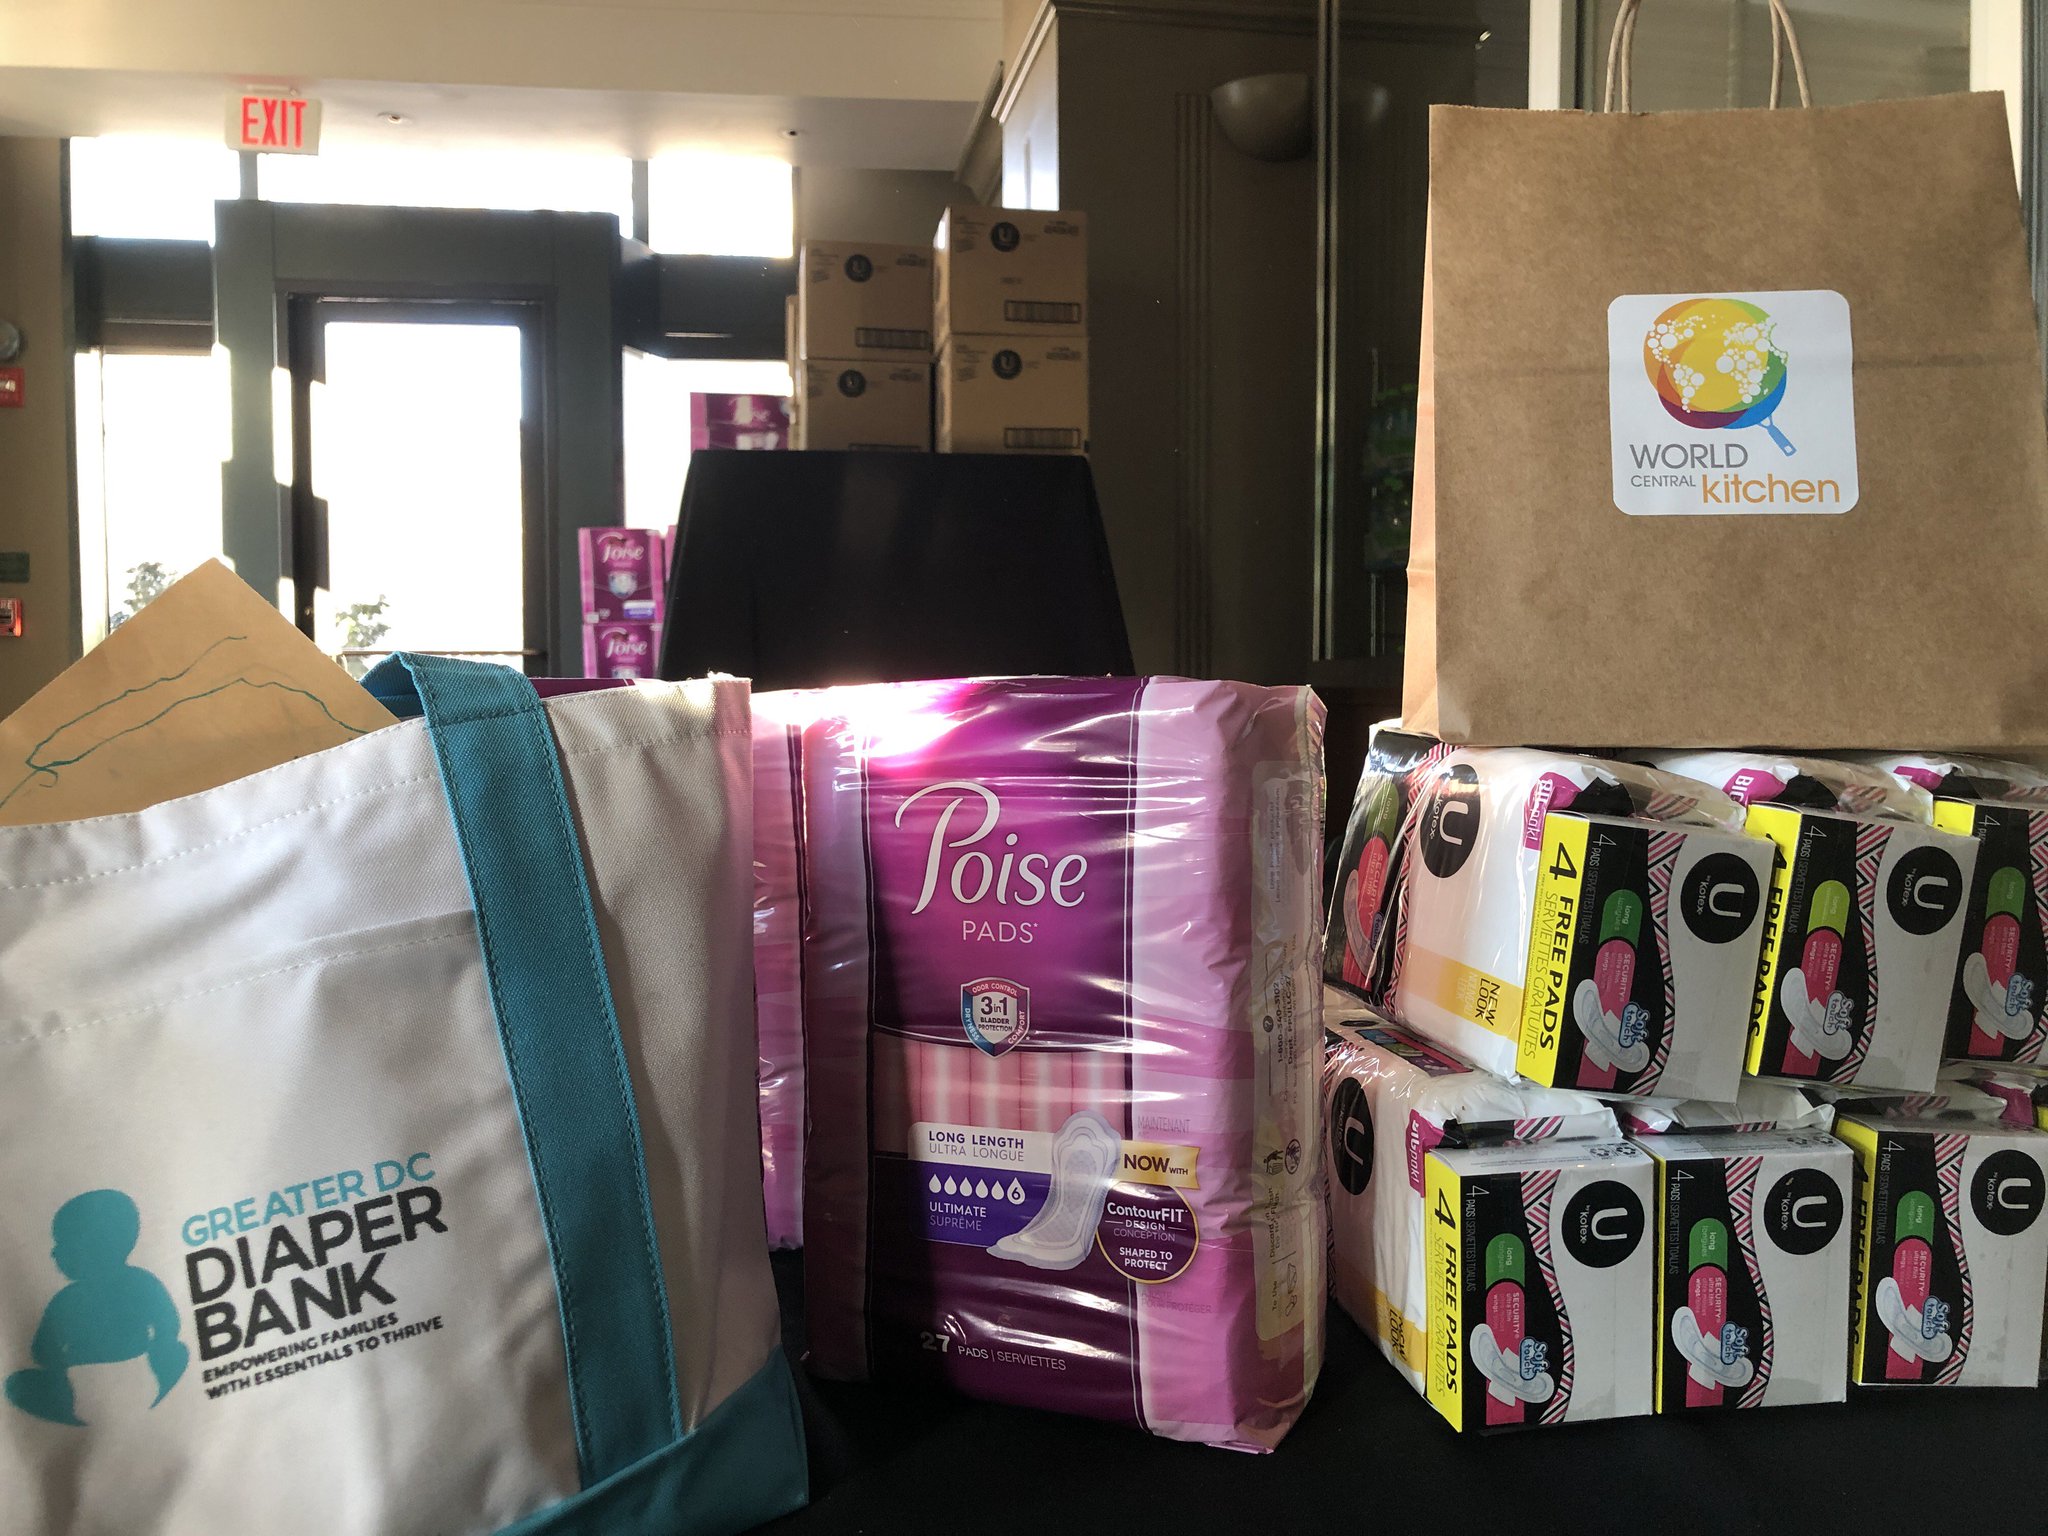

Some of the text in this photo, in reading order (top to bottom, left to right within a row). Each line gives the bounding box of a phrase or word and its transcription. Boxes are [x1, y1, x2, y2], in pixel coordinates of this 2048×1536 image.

[242, 97, 308, 149] EXIT
[1629, 443, 1749, 469] WORLD
[1630, 473, 1840, 503] CENTRAL kitchen
[1440, 801, 1469, 845] U
[1803, 825, 1828, 838] 4
[1977, 814, 2001, 827] 4
[895, 781, 1088, 915] Poise
[1592, 833, 1617, 847] 4
[1709, 883, 1745, 918] U
[1913, 875, 1949, 910] U
[1621, 905, 1633, 925] long
[962, 920, 1035, 944] PADS
[1535, 890, 1558, 976] SERVIETTES
[1539, 842, 1578, 1050] 4 FREE PADS
[972, 983, 1018, 997] ODOR CONTROL
[1474, 978, 1491, 1018] LOOK
[1485, 982, 1501, 1026] NEW
[964, 1007, 980, 1041] DRYNESS
[978, 1024, 1013, 1032] PROTECTION
[980, 1016, 1010, 1025] BLADDER
[1523, 976, 1547, 1059] GRATUITES
[1622, 1009, 1635, 1043] touch
[1630, 1009, 1649, 1043] Soft
[1827, 998, 1841, 1031] touch
[1834, 999, 1853, 1031] Soft
[929, 1130, 1024, 1149] LONG LENGTH
[1138, 1115, 1191, 1133] MAINTENANT
[929, 1143, 1025, 1162] ULTRA LONGUE
[1344, 1116, 1365, 1166] U
[1882, 1138, 1906, 1152] 4
[1124, 1153, 1189, 1176] NOW WITH
[1671, 1169, 1695, 1181] 4
[1880, 1152, 1891, 1170] PADS
[181, 1152, 435, 1247] GREATER DC
[1011, 1187, 1021, 1200] 6
[1466, 1184, 1490, 1198] 4
[1671, 1182, 1681, 1201] PADS
[1997, 1177, 2032, 1210] U
[929, 1201, 987, 1218] ULTIMATE
[929, 1214, 982, 1231] SUPRÊME
[1107, 1202, 1185, 1223] ContourFIT
[1465, 1198, 1476, 1218] PADS
[1791, 1195, 1828, 1229] U
[1915, 1204, 1925, 1223] long
[1113, 1228, 1176, 1242] CONCEPTION
[1125, 1219, 1166, 1231] DESIGN
[1591, 1207, 1628, 1241] U
[185, 1186, 448, 1306] DIAPER
[1119, 1246, 1173, 1261] SHAPED TO
[1708, 1230, 1717, 1250] long
[1124, 1258, 1168, 1271] PROTECT
[1505, 1247, 1514, 1266] long
[1434, 1187, 1457, 1394] 4 FREE PADS
[195, 1252, 397, 1361] BANK
[1433, 1232, 1445, 1397] SERVIETTES GRATUITES
[1924, 1302, 1935, 1333] touch
[1934, 1301, 1949, 1333] Soft
[203, 1312, 399, 1383] EMPOWERING FAMILIES
[204, 1315, 444, 1400] WITH ESSENTIALS TO THRIVE
[920, 1331, 1067, 1371] 27 PADS SERVIETTES
[1523, 1342, 1532, 1375] touch
[1531, 1342, 1547, 1373] Soft
[1724, 1327, 1733, 1359] touch
[1732, 1327, 1748, 1359] Soft
